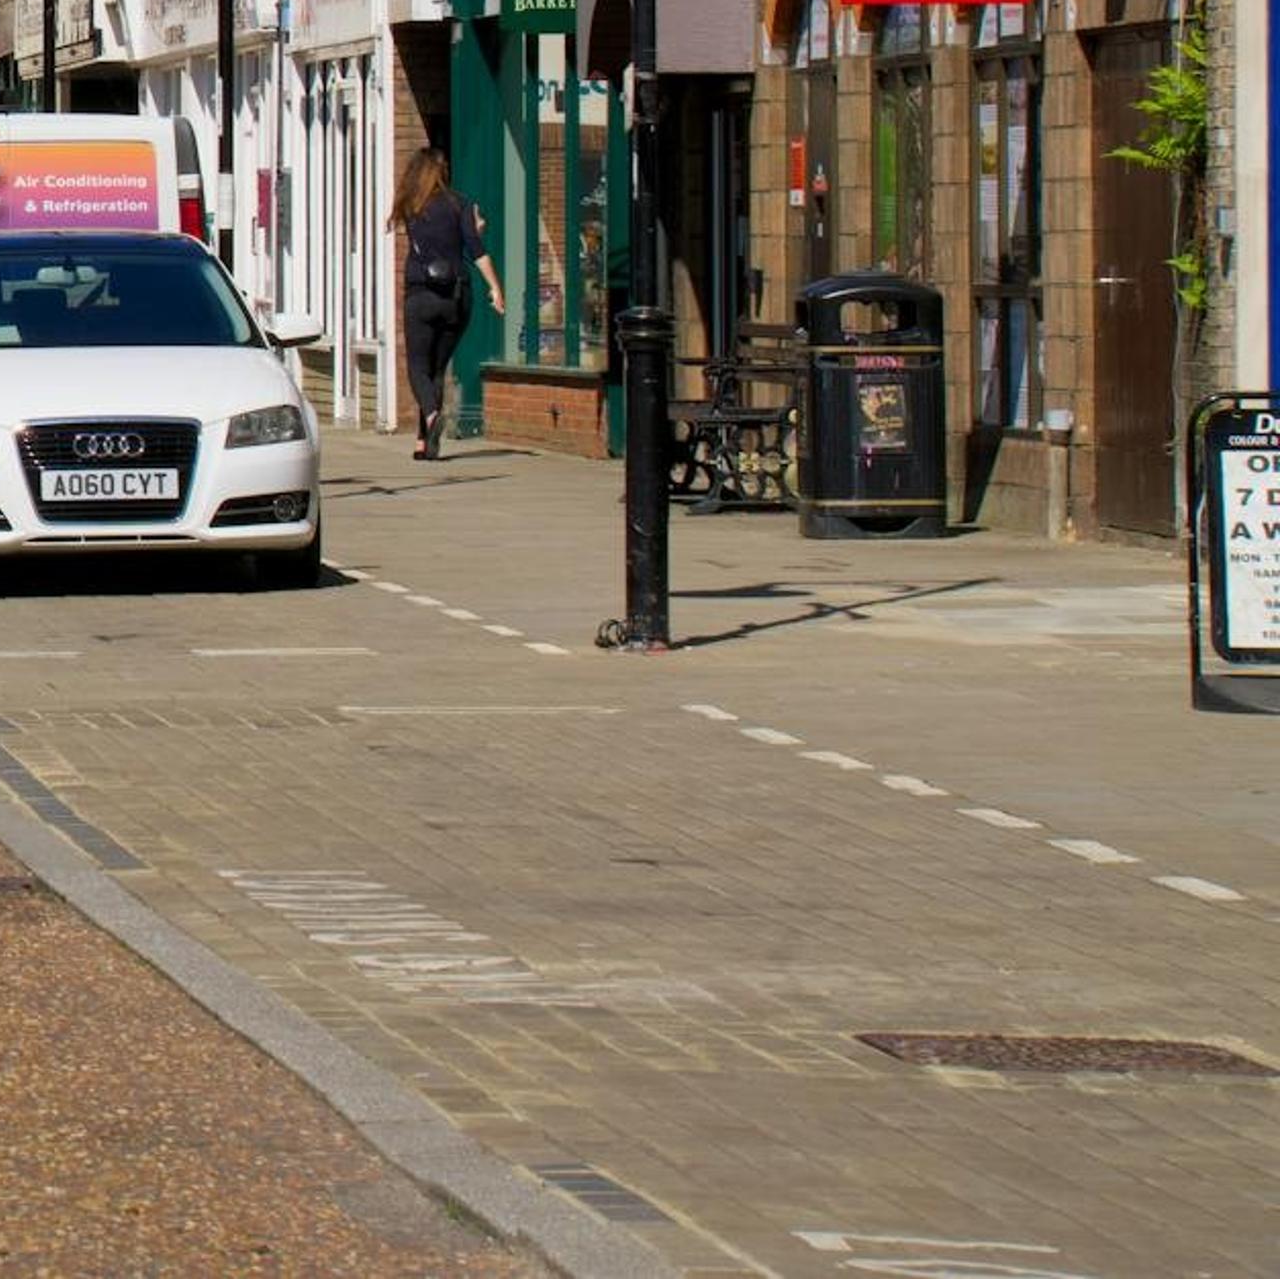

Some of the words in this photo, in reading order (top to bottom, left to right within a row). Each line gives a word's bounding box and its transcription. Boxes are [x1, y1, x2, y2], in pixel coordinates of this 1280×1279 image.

[14, 175, 40, 187] Air
[44, 174, 147, 188] Conditioning
[24, 199, 37, 212] &
[42, 199, 147, 213] Refrigeration
[53, 473, 115, 496] AO60
[122, 473, 168, 495] CYT
[1236, 488, 1253, 506] 7
[1231, 522, 1252, 539] A
[1231, 554, 1261, 563] MON
